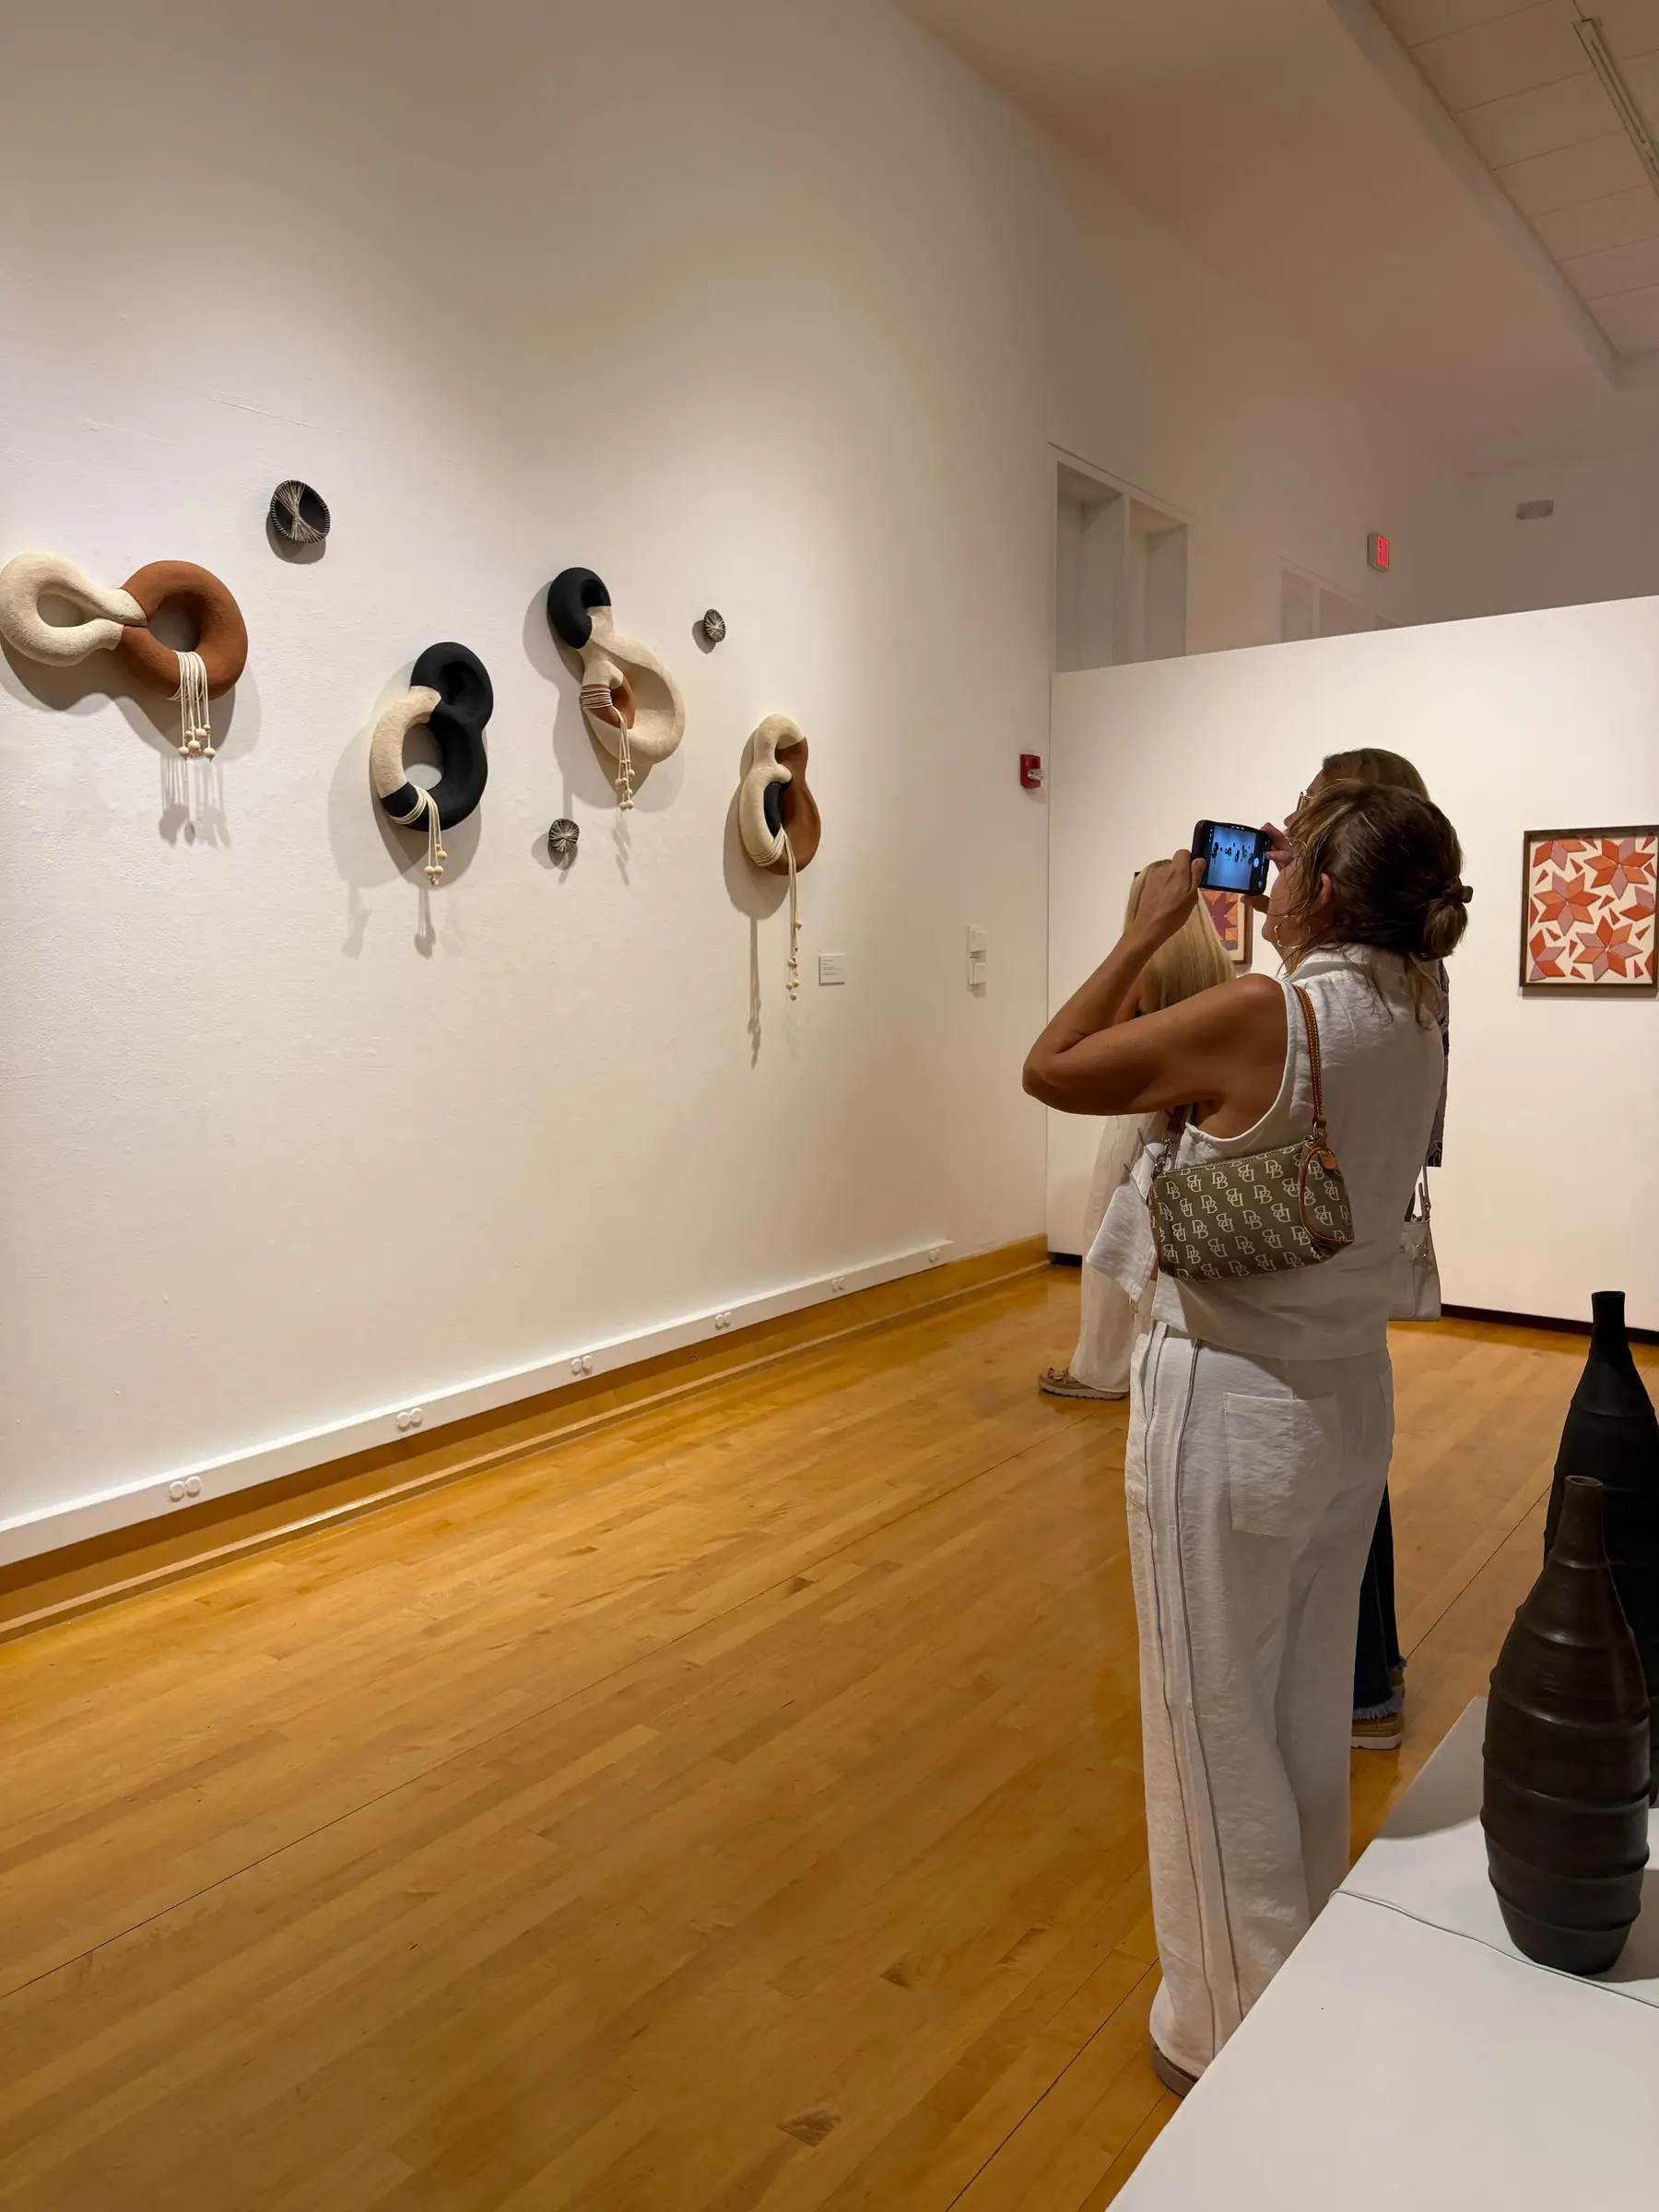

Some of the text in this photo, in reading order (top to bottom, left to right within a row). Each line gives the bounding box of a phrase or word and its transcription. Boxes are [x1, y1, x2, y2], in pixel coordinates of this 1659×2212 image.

[1166, 1181, 1180, 1199] DB
[1187, 1174, 1202, 1193] DB
[1212, 1171, 1229, 1189] DB
[1238, 1164, 1255, 1182] DB
[1265, 1159, 1284, 1179] DB
[1324, 1180, 1340, 1201] DB
[1179, 1198, 1194, 1217] DB
[1200, 1194, 1218, 1214] DB
[1225, 1188, 1244, 1207] DB
[1253, 1184, 1273, 1204] DB
[1314, 1206, 1334, 1225] DB
[1171, 1222, 1186, 1241] DB
[1192, 1219, 1209, 1239] DB
[1216, 1212, 1235, 1232] DB
[1242, 1209, 1263, 1230] DB
[1270, 1203, 1292, 1223] DB
[1163, 1243, 1180, 1265] DB
[1185, 1244, 1201, 1264] DB
[1207, 1238, 1229, 1258] DB
[1233, 1235, 1255, 1255] DB
[1262, 1229, 1283, 1249] DB
[1200, 1263, 1222, 1279] DB
[1228, 1260, 1250, 1276] DB
[1254, 1253, 1277, 1271] DB
